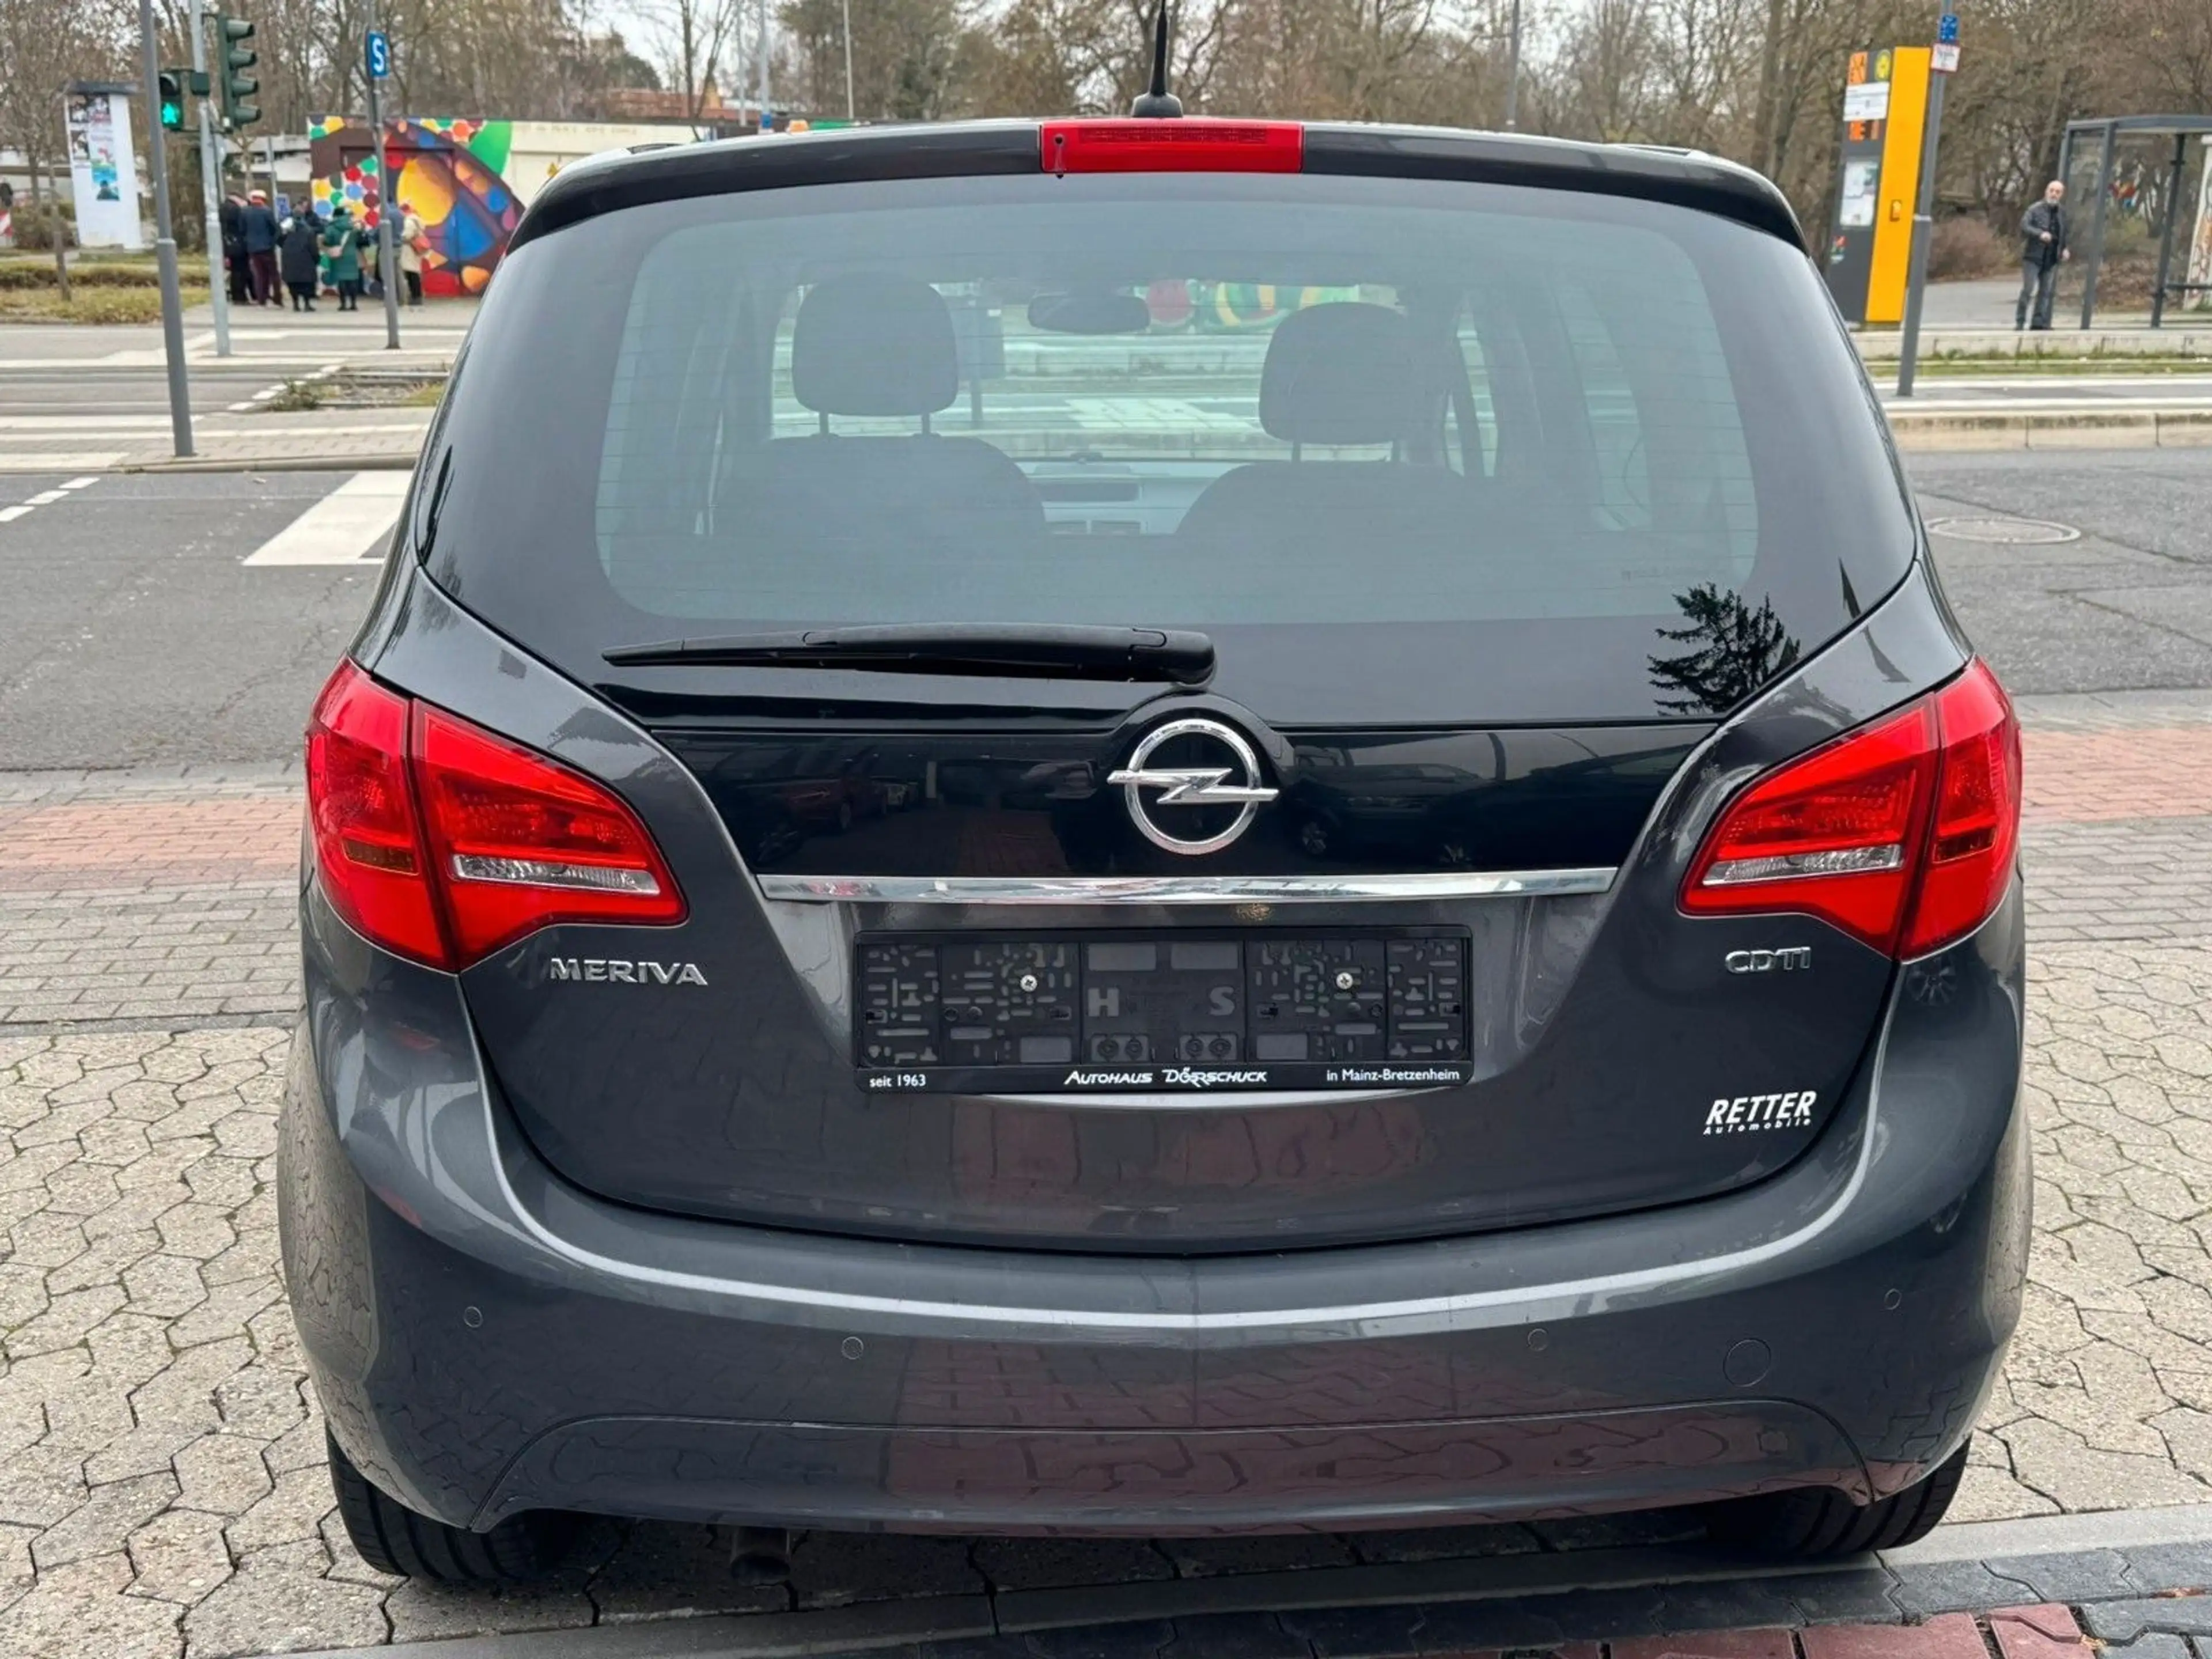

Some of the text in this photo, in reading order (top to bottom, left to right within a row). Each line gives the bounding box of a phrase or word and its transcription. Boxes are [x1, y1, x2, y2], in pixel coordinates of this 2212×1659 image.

[372, 37, 384, 73] S
[550, 958, 709, 986] MERIVA
[1725, 946, 1811, 974] CDTI
[869, 1073, 926, 1088] seit 1963
[1064, 1070, 1153, 1085] AUTOHAUS
[1326, 1067, 1460, 1082] in Mainz-Bretzenheim
[1705, 1090, 1817, 1126] RETTER
